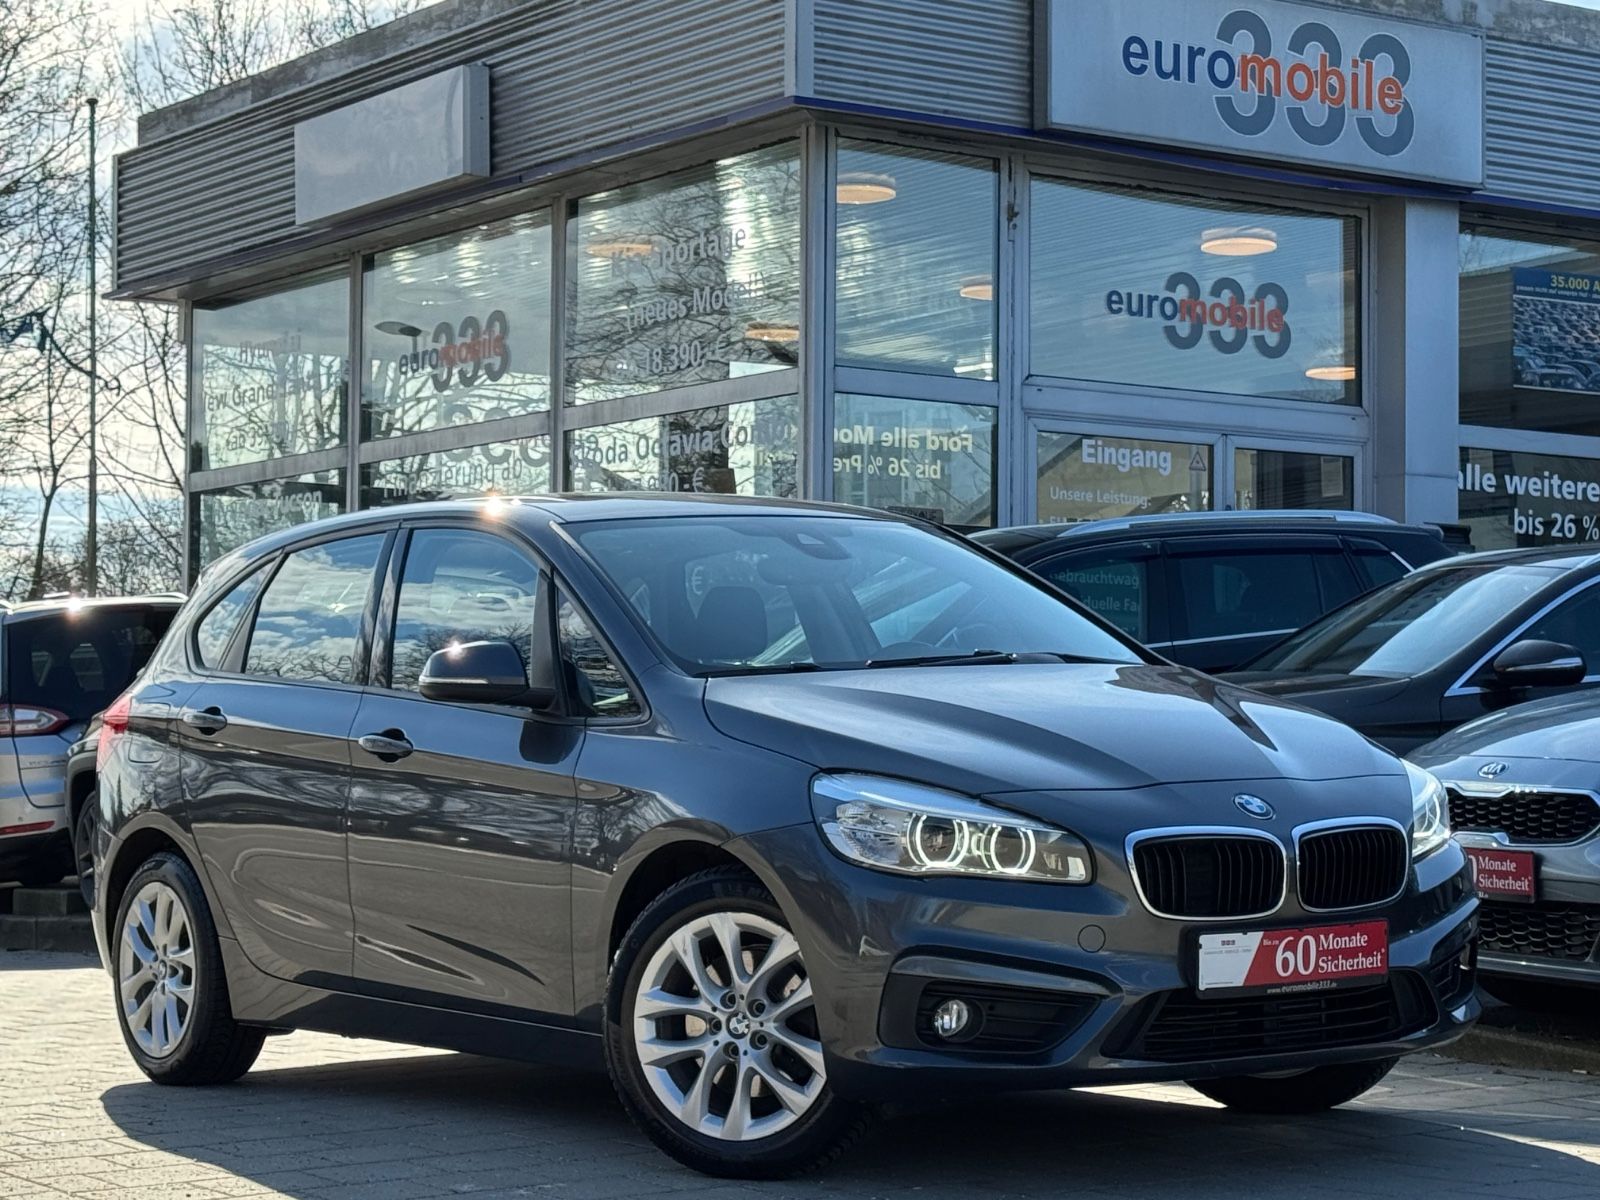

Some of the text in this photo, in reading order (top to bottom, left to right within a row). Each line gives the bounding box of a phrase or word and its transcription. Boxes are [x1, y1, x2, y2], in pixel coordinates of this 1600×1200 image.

[1122, 9, 1415, 156] euromobile 333
[1550, 274, 1590, 291] 35.000
[1106, 271, 1292, 359] euromobile 333
[1081, 438, 1172, 476] Eingang
[1050, 487, 1093, 501] Unsere
[1504, 470, 1600, 502] weitere
[1513, 507, 1600, 541] bis 26 %
[1479, 855, 1517, 872] Monate
[1275, 935, 1317, 978] 60
[1319, 932, 1368, 951] Monate
